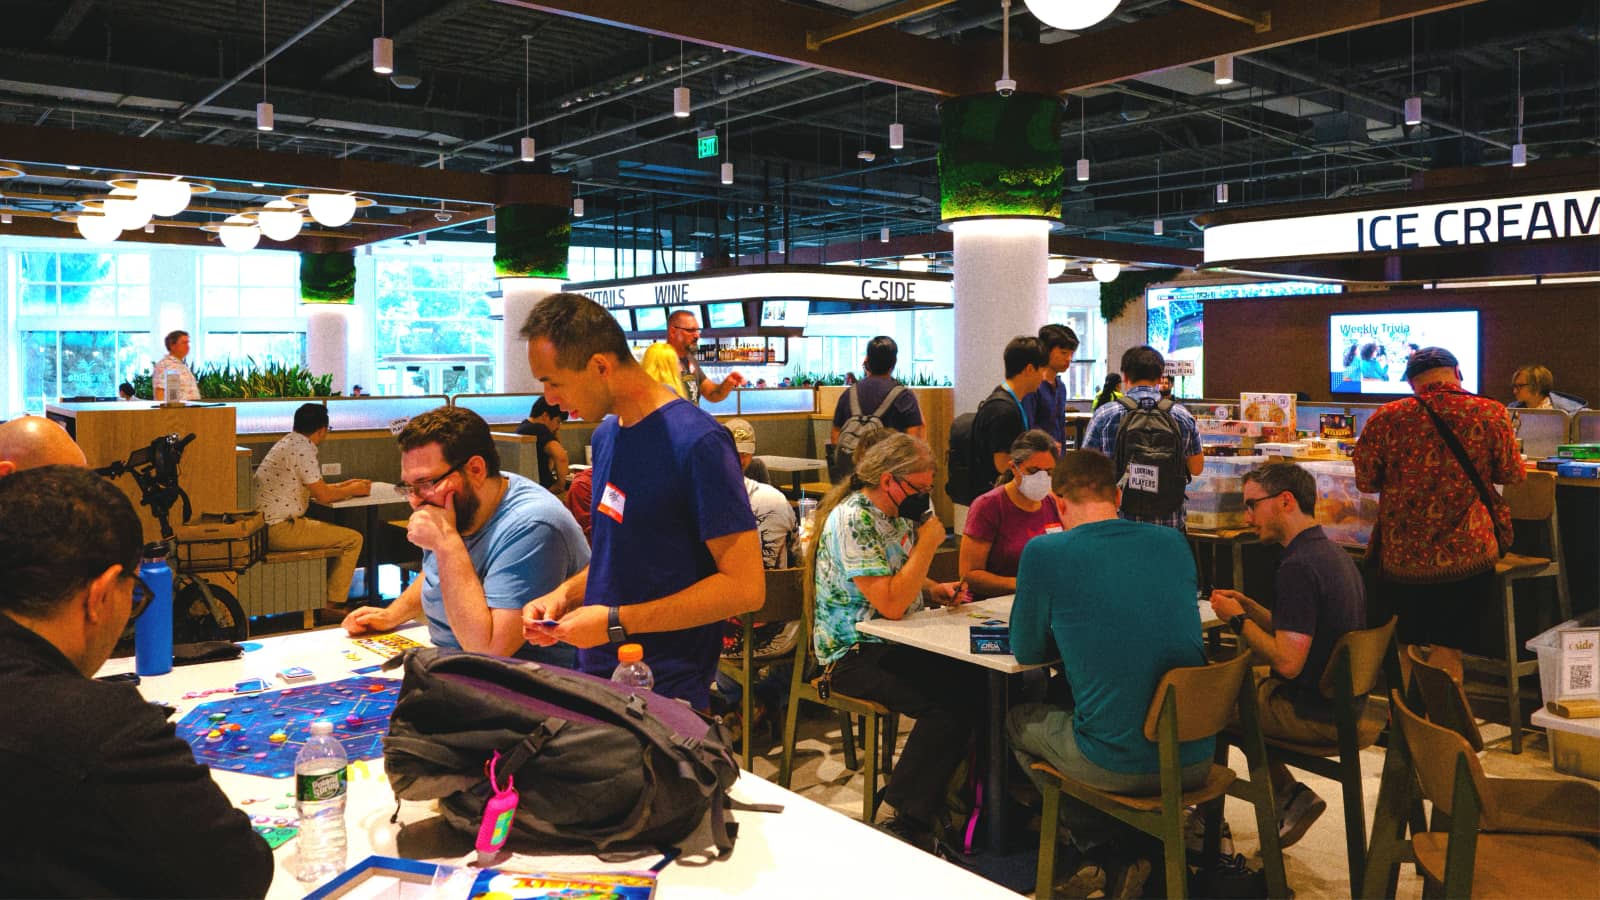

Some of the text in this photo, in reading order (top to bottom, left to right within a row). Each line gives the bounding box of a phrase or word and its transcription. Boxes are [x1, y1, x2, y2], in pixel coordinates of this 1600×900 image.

[1357, 196, 1600, 252] ICE CREAM
[655, 283, 690, 304] WINE
[861, 279, 916, 302] C-SIDE
[1340, 323, 1410, 335] Weekly Trivia
[1134, 467, 1154, 477] LOOKING
[1131, 477, 1156, 488] PLAYERS
